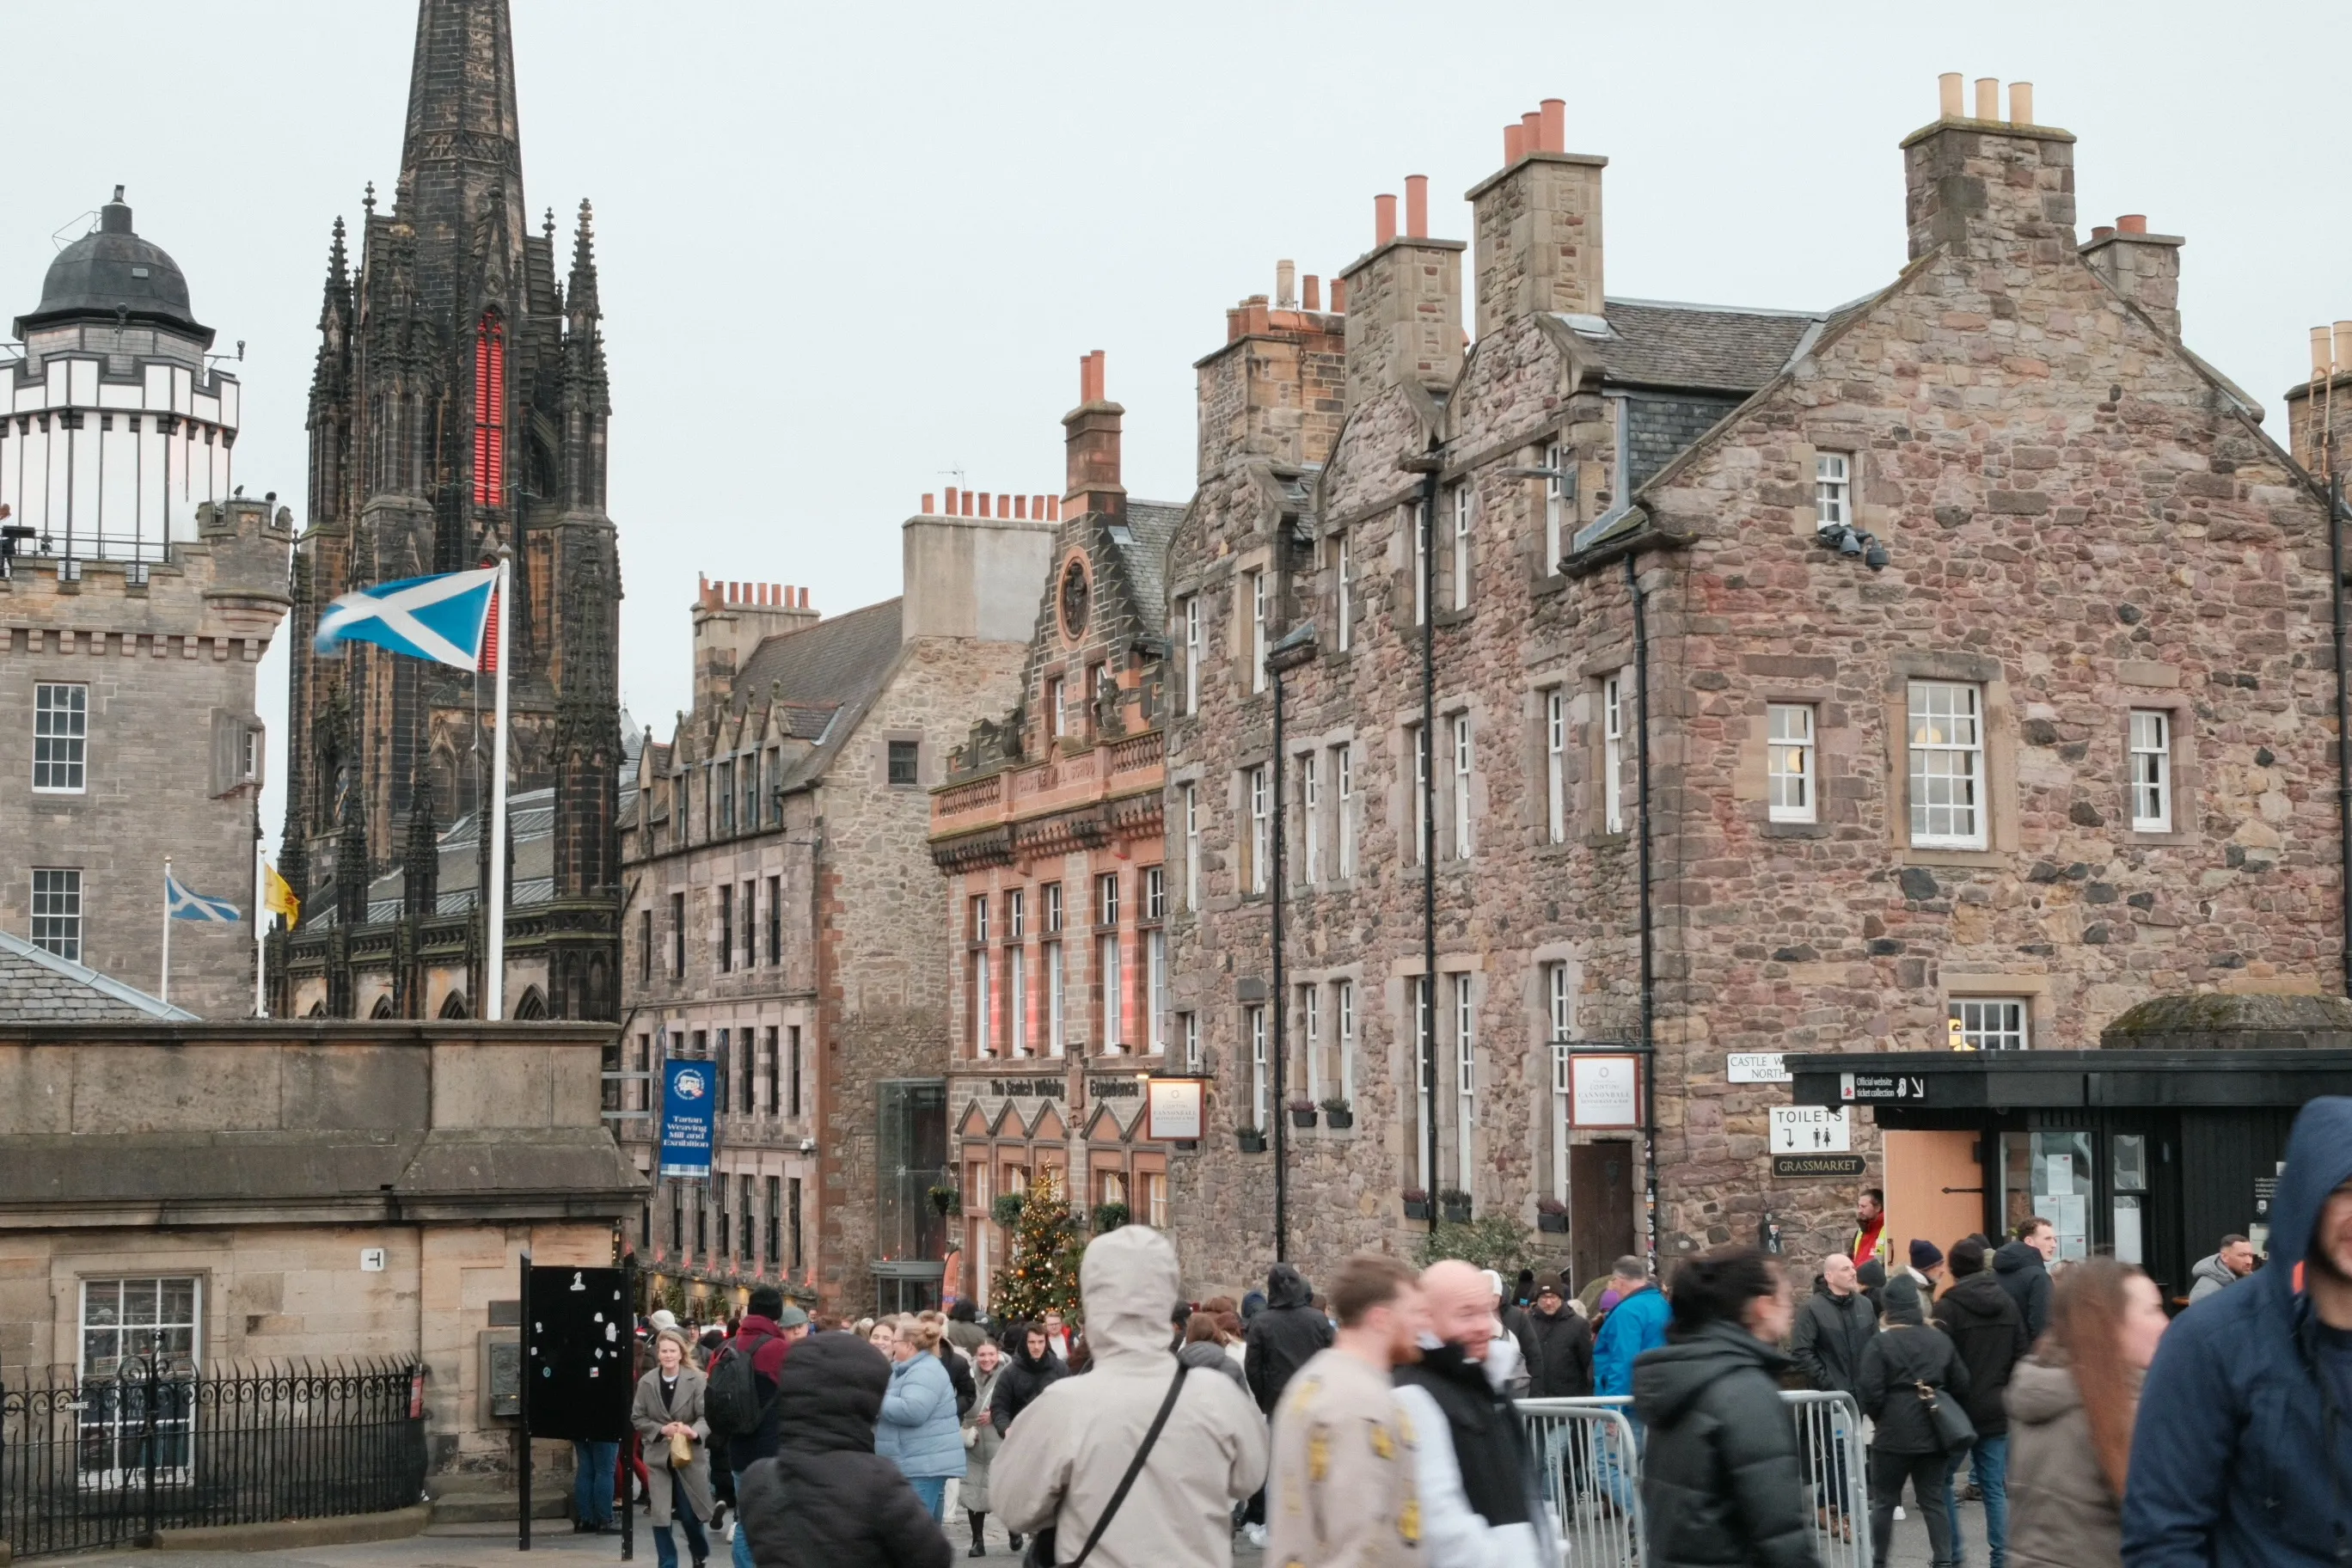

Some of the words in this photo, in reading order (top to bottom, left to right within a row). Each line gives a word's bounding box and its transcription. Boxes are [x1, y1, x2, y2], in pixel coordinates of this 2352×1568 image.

[1071, 761, 1095, 780] SCHOO
[1730, 1057, 1767, 1067] CASTLE
[1751, 1069, 1786, 1078] NORTH
[1857, 1076, 1874, 1086] Official
[1873, 1076, 1893, 1086] website
[990, 1079, 1005, 1096] The
[1006, 1078, 1033, 1096] Scotch
[1034, 1078, 1065, 1102] Whisky
[1089, 1077, 1140, 1099] Experience
[1857, 1087, 1871, 1097] ticket
[1871, 1087, 1895, 1097] collection
[1777, 1111, 1842, 1123] TOILETS
[667, 1124, 707, 1133] Weaving
[664, 1139, 709, 1148] Exhibition
[1779, 1160, 1857, 1171] GRASSMARKET
[65, 1401, 89, 1411] PRIVATE
